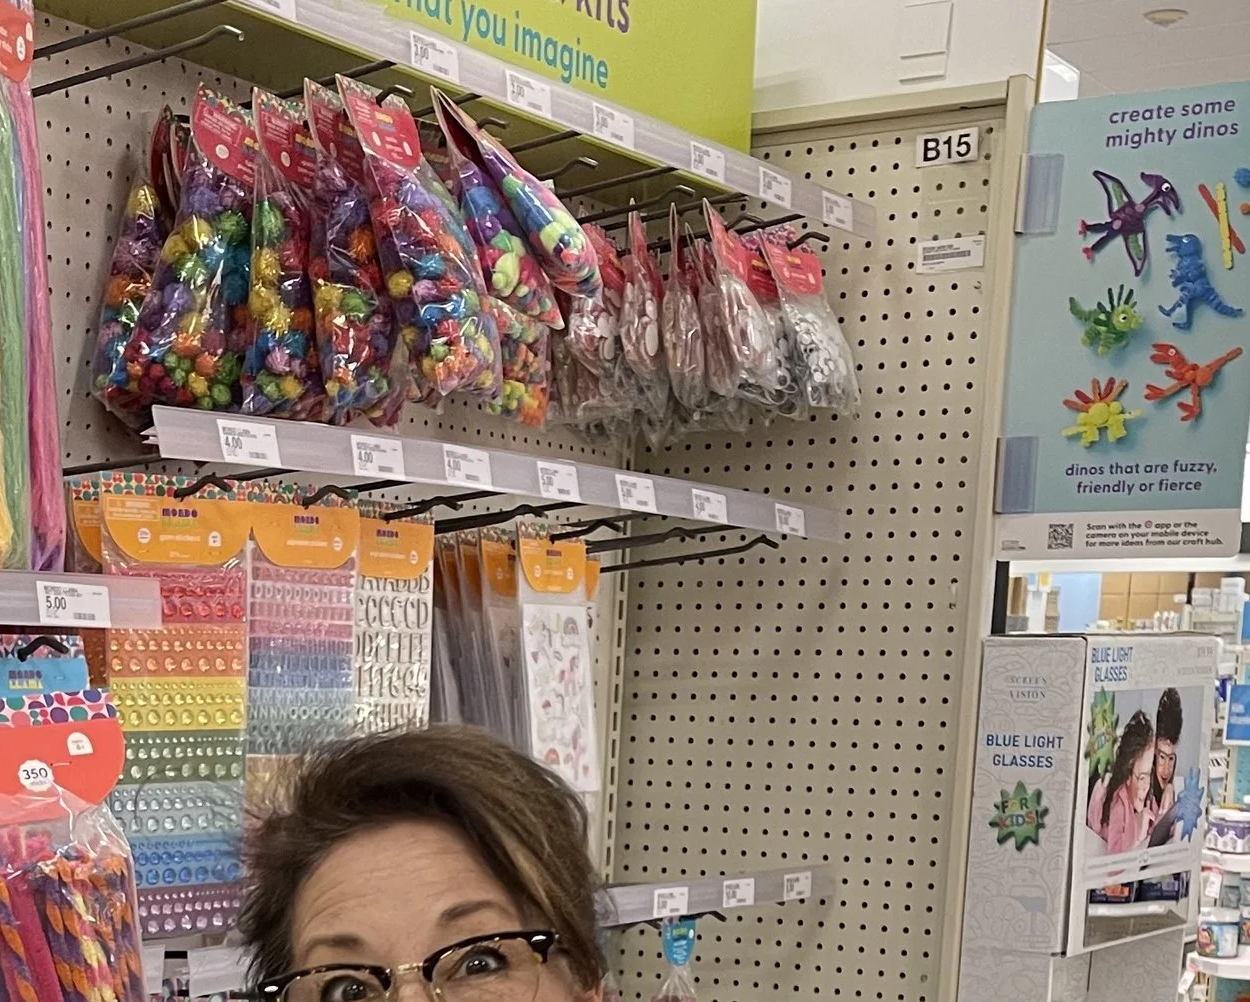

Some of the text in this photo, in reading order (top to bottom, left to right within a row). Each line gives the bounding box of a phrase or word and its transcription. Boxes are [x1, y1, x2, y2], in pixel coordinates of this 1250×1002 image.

[460, 0, 609, 89] you imagine
[1109, 100, 1236, 124] create some
[1106, 121, 1239, 149] mighty dinos
[923, 133, 971, 162] B15
[1065, 460, 1217, 477] dinos that are fuzzy,
[1077, 479, 1202, 496] friendly or fierce
[1086, 523, 1107, 531] Scan
[1154, 522, 1171, 531] app
[1121, 539, 1144, 547] ideas
[1183, 538, 1203, 546] craft
[1205, 537, 1224, 545] hub.
[1131, 531, 1149, 540] your
[1151, 530, 1179, 538] mobile
[45, 596, 67, 610] 5.00
[1091, 646, 1134, 664] BLUE LIGHT
[1094, 666, 1128, 682] GLASSES
[986, 734, 1064, 749] BLUE LIGHT
[992, 754, 1054, 769] GLASSES
[22, 767, 49, 780] 350
[1001, 797, 1030, 814] FOR
